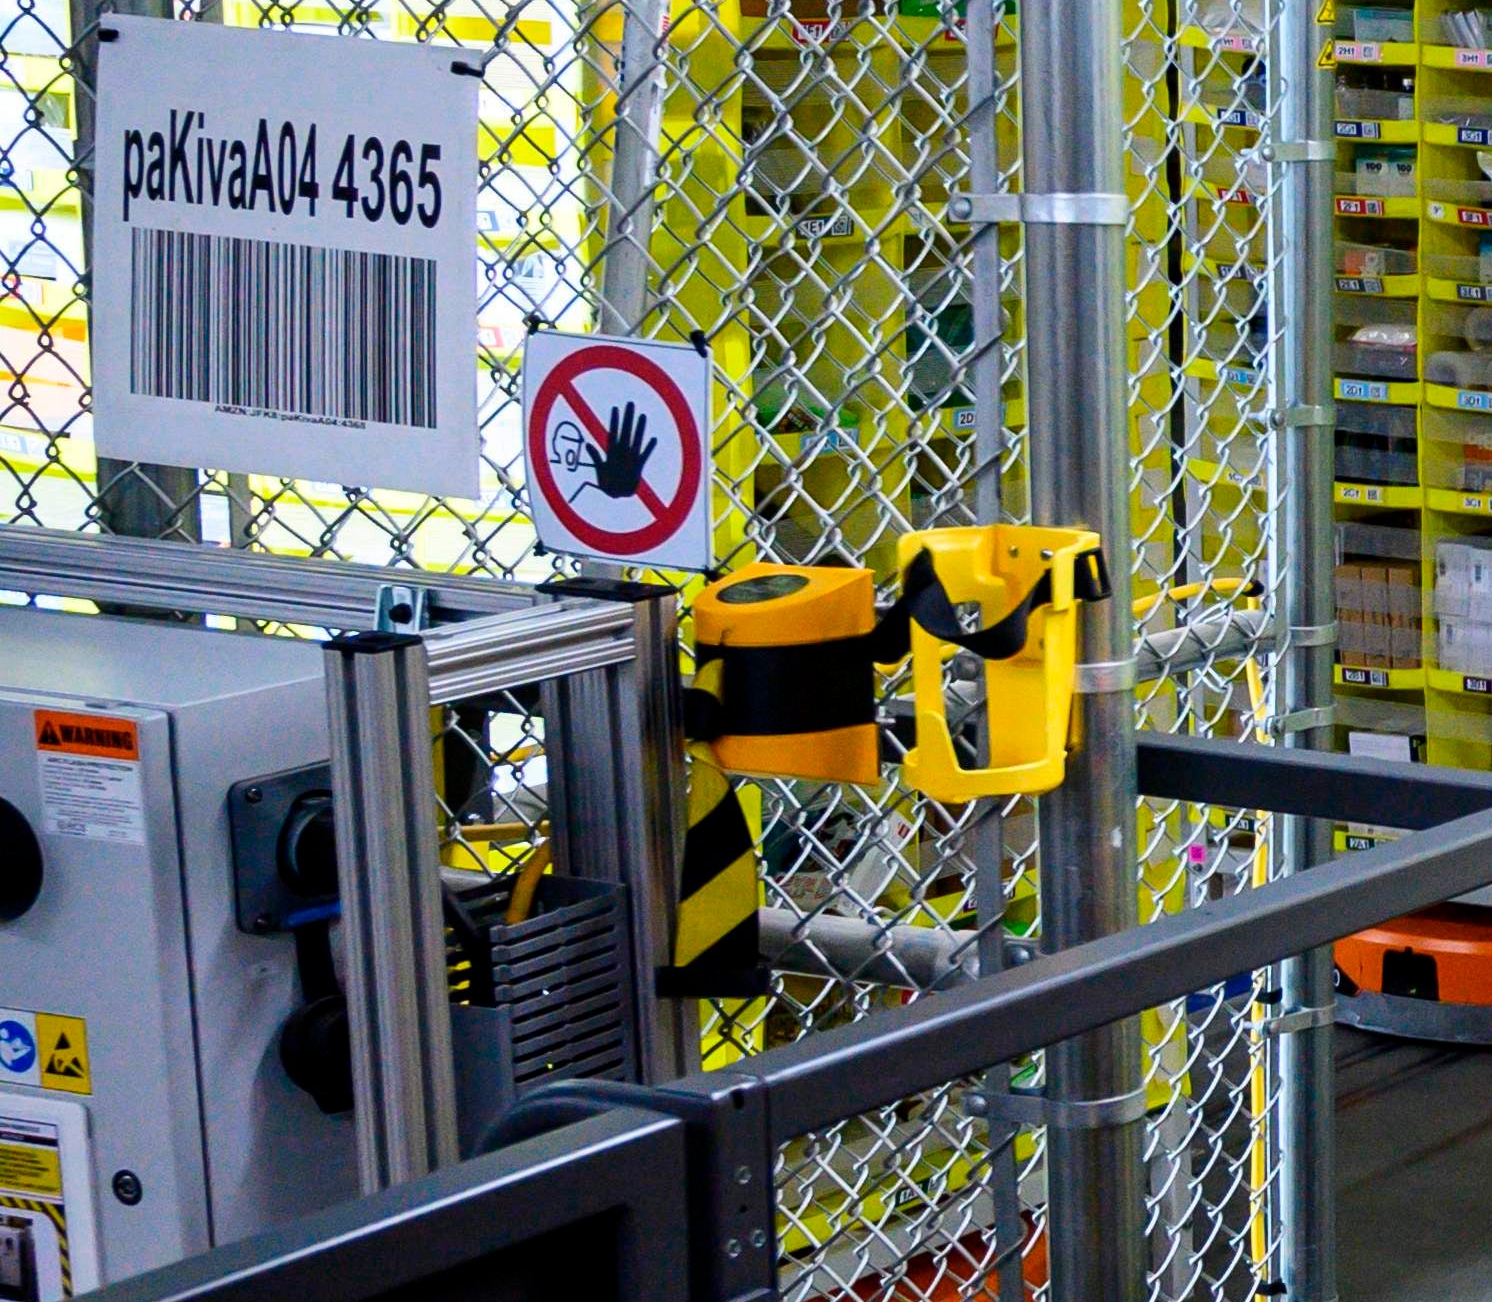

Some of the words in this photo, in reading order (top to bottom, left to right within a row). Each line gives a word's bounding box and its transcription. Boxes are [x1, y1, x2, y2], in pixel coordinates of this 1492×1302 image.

[123, 109, 319, 222] paKivaA04
[332, 133, 442, 229] 4365
[58, 723, 134, 751] WARNING
